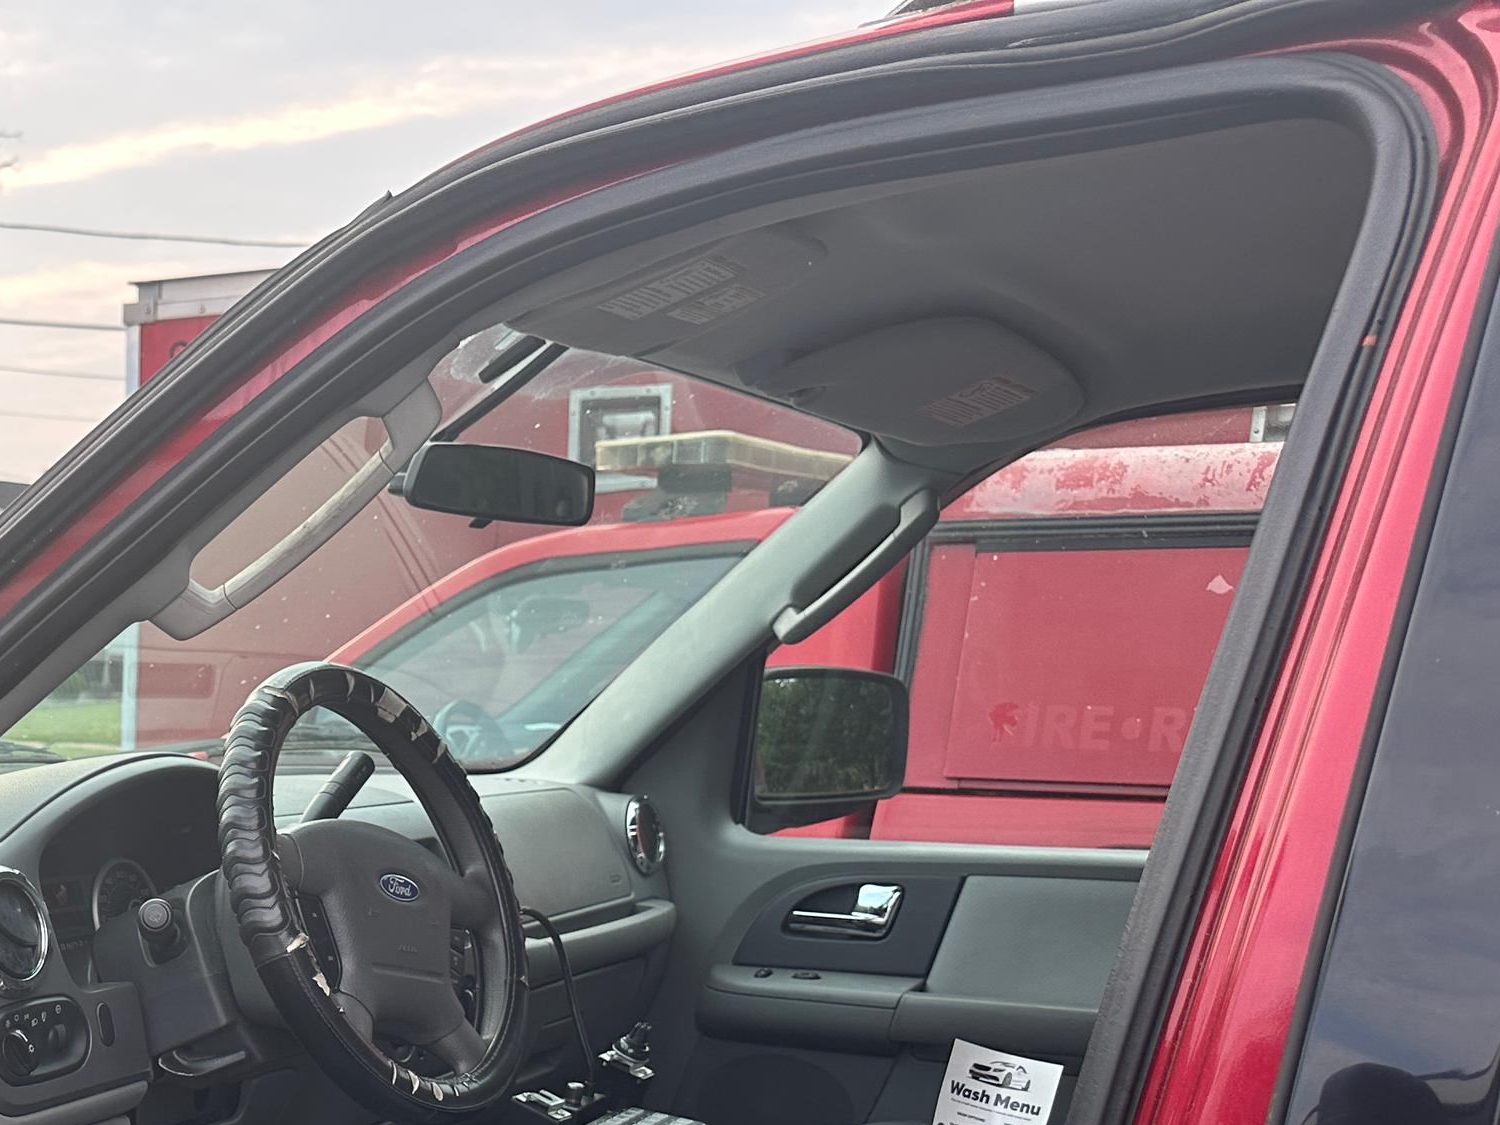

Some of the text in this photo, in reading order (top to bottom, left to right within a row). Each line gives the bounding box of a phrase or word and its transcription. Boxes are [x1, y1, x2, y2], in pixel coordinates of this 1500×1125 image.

[388, 876, 412, 897] Ford
[950, 1079, 991, 1105] Wash
[993, 1093, 1042, 1116] Menu
